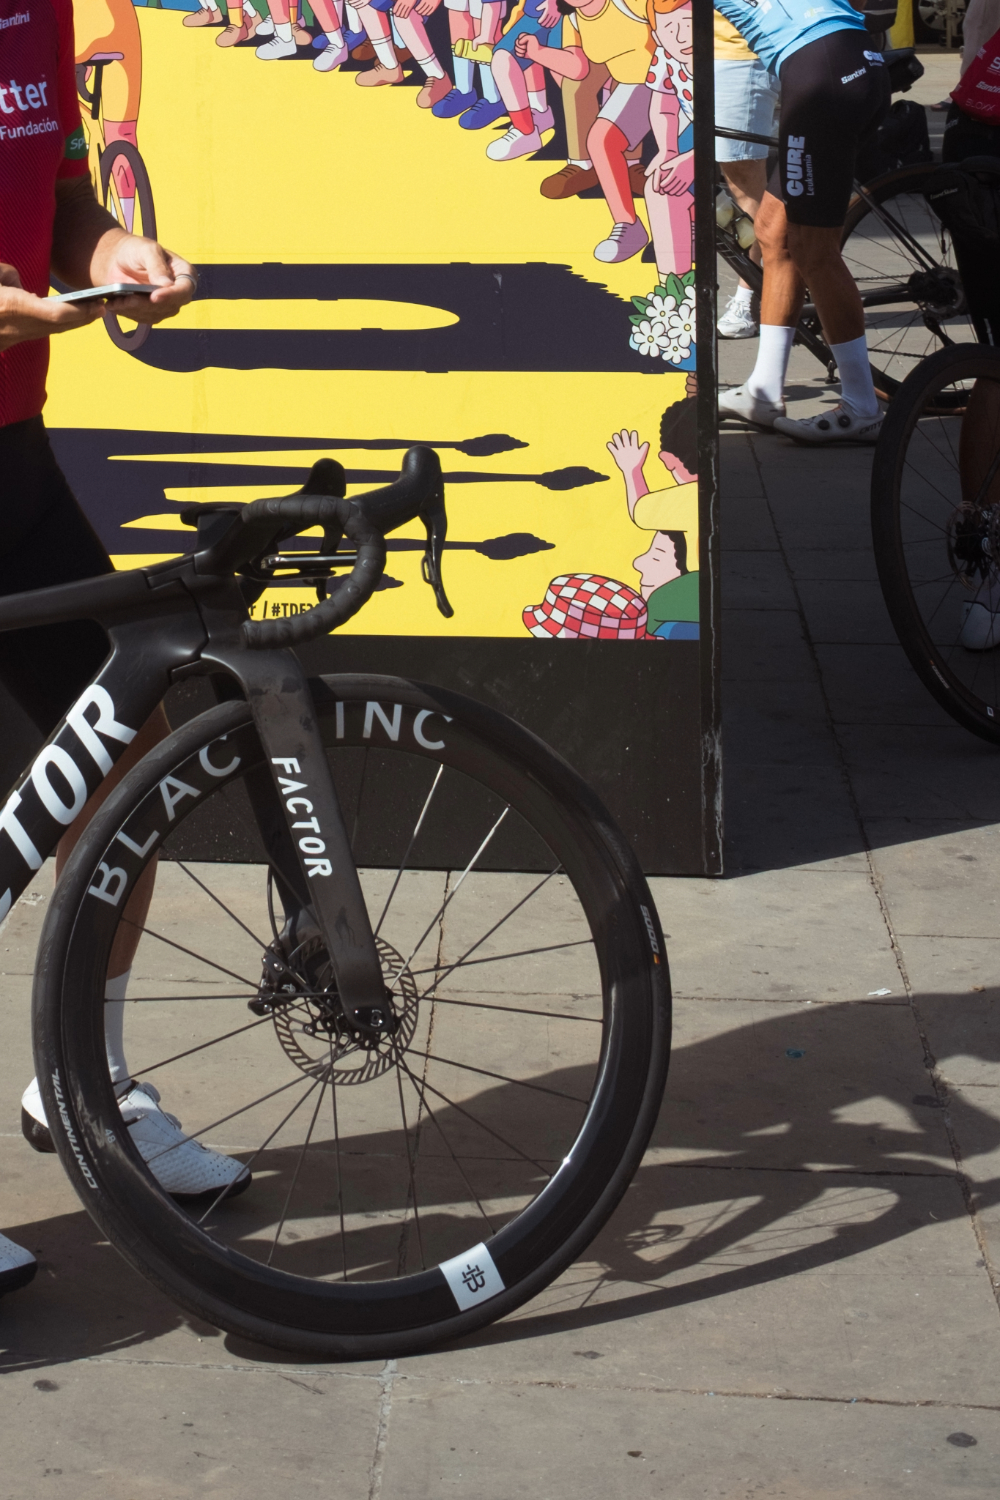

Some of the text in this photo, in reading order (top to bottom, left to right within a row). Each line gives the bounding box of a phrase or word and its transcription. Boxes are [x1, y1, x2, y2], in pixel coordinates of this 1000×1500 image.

[840, 65, 867, 85] Santini
[786, 134, 806, 197] CURE
[804, 154, 815, 197] Leukaemia
[87, 734, 243, 907] BLAC
[271, 755, 334, 878] FACTOR
[51, 1067, 99, 1189] CONTINENTAL
